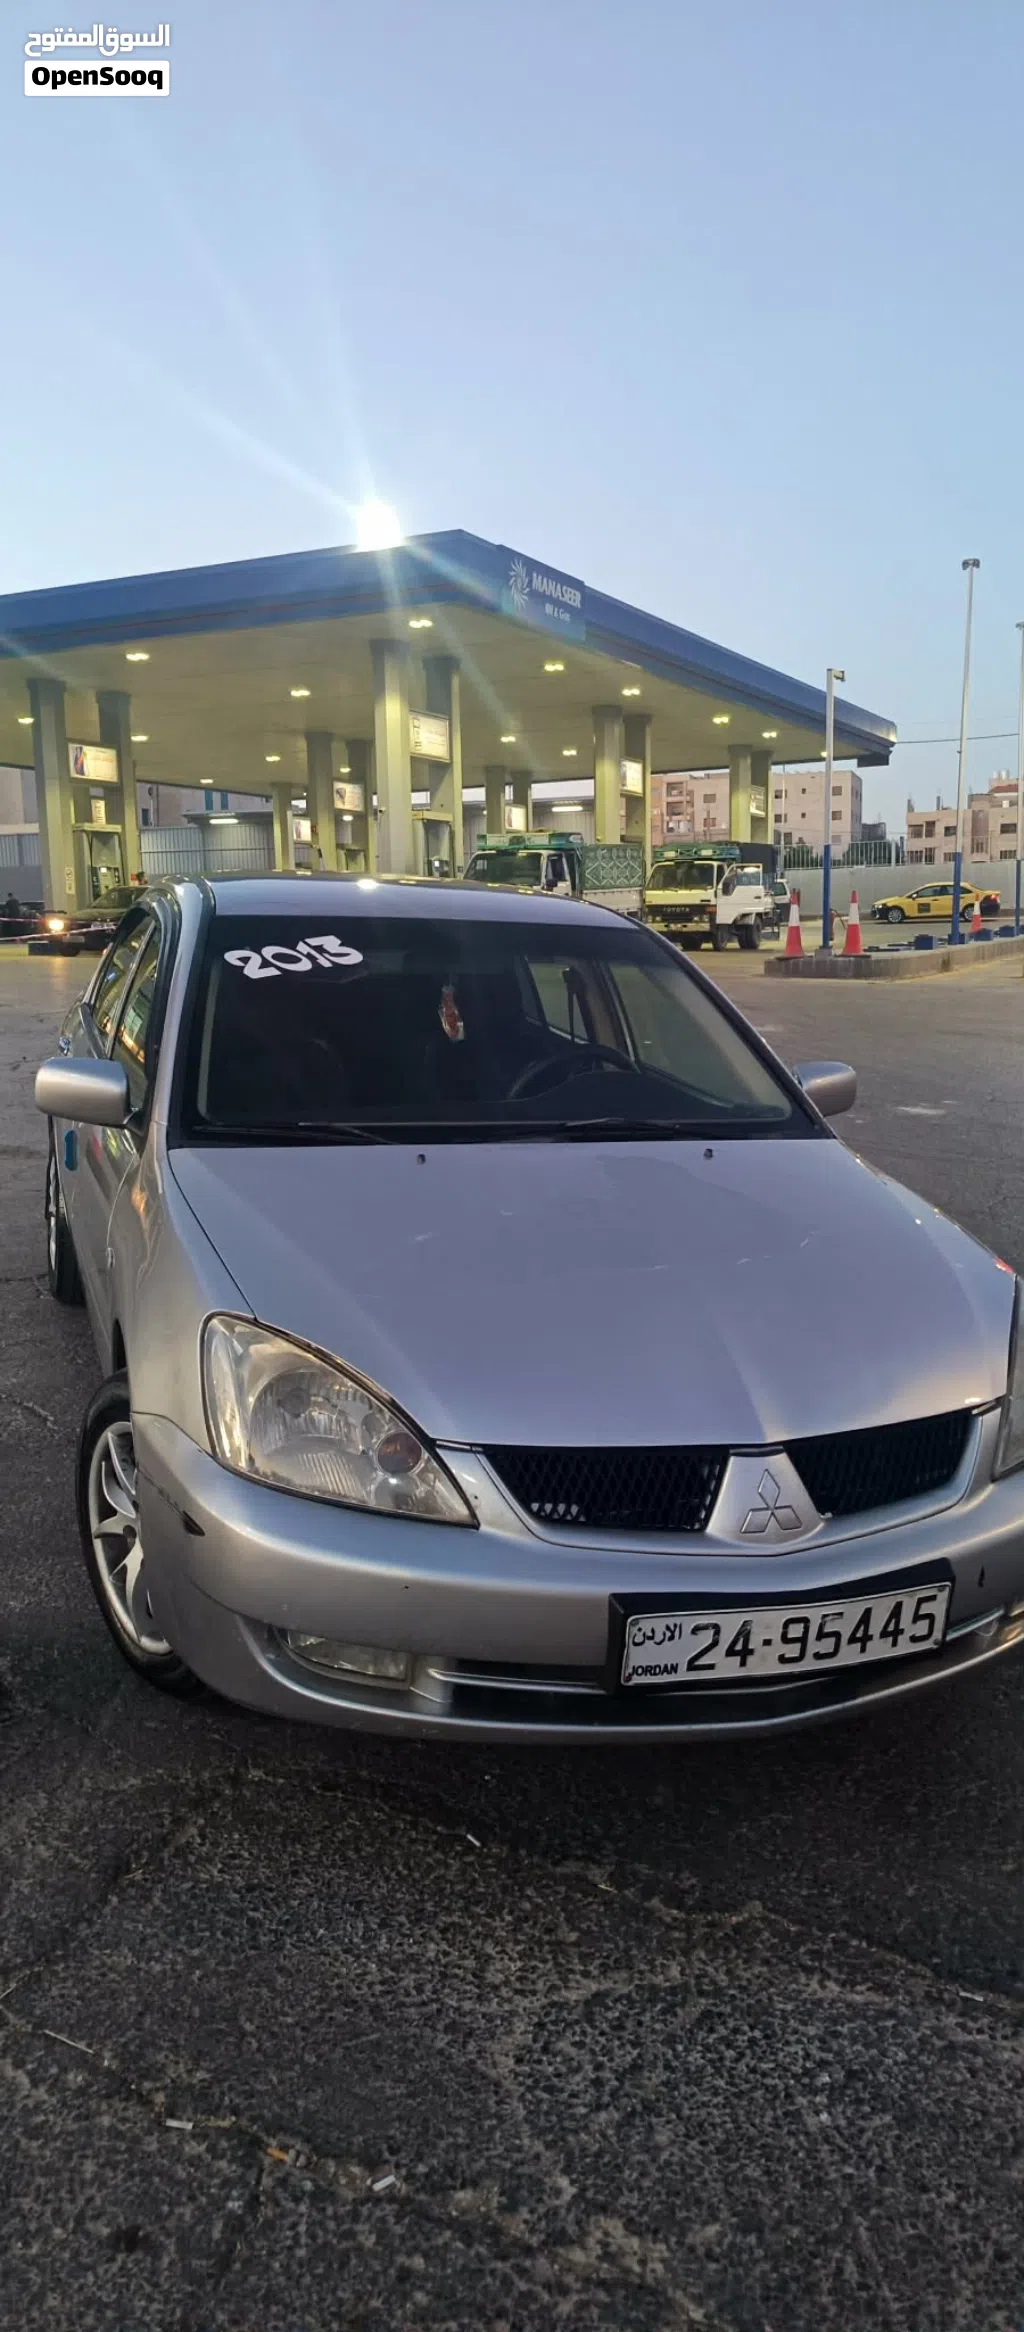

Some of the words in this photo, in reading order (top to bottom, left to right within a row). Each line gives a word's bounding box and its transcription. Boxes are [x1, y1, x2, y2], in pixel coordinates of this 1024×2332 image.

[532, 571, 581, 609] MANASEER
[223, 935, 364, 979] 2013
[686, 1594, 938, 1673] 24-95445
[627, 1662, 679, 1678] JORDAN
